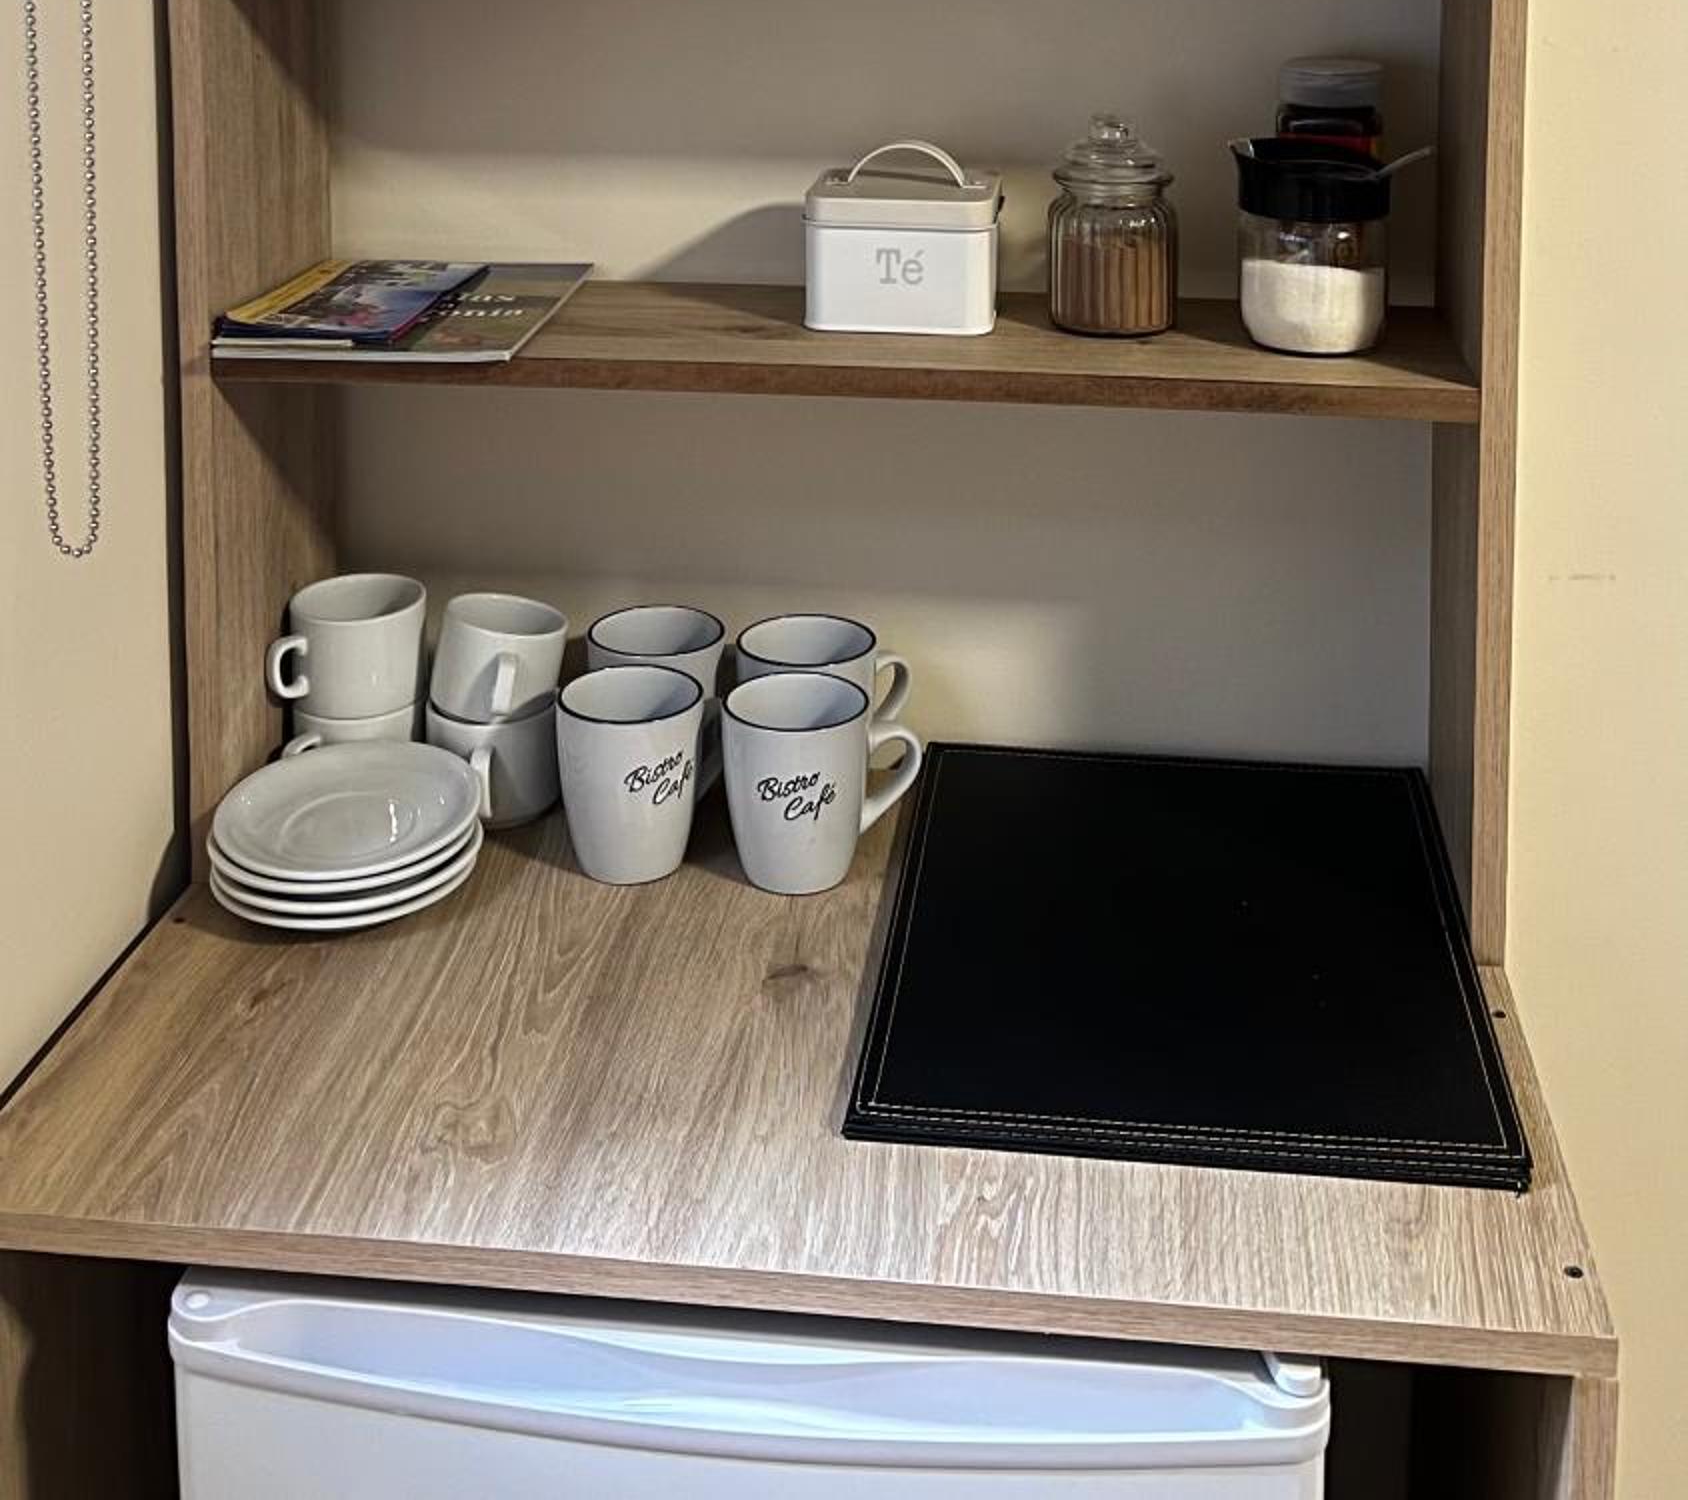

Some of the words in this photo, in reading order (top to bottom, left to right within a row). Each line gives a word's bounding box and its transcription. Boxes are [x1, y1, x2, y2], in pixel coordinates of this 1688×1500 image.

[876, 248, 925, 285] Té
[624, 750, 683, 793] Bistro
[757, 771, 821, 801] Bistro
[784, 783, 836, 821] Café
